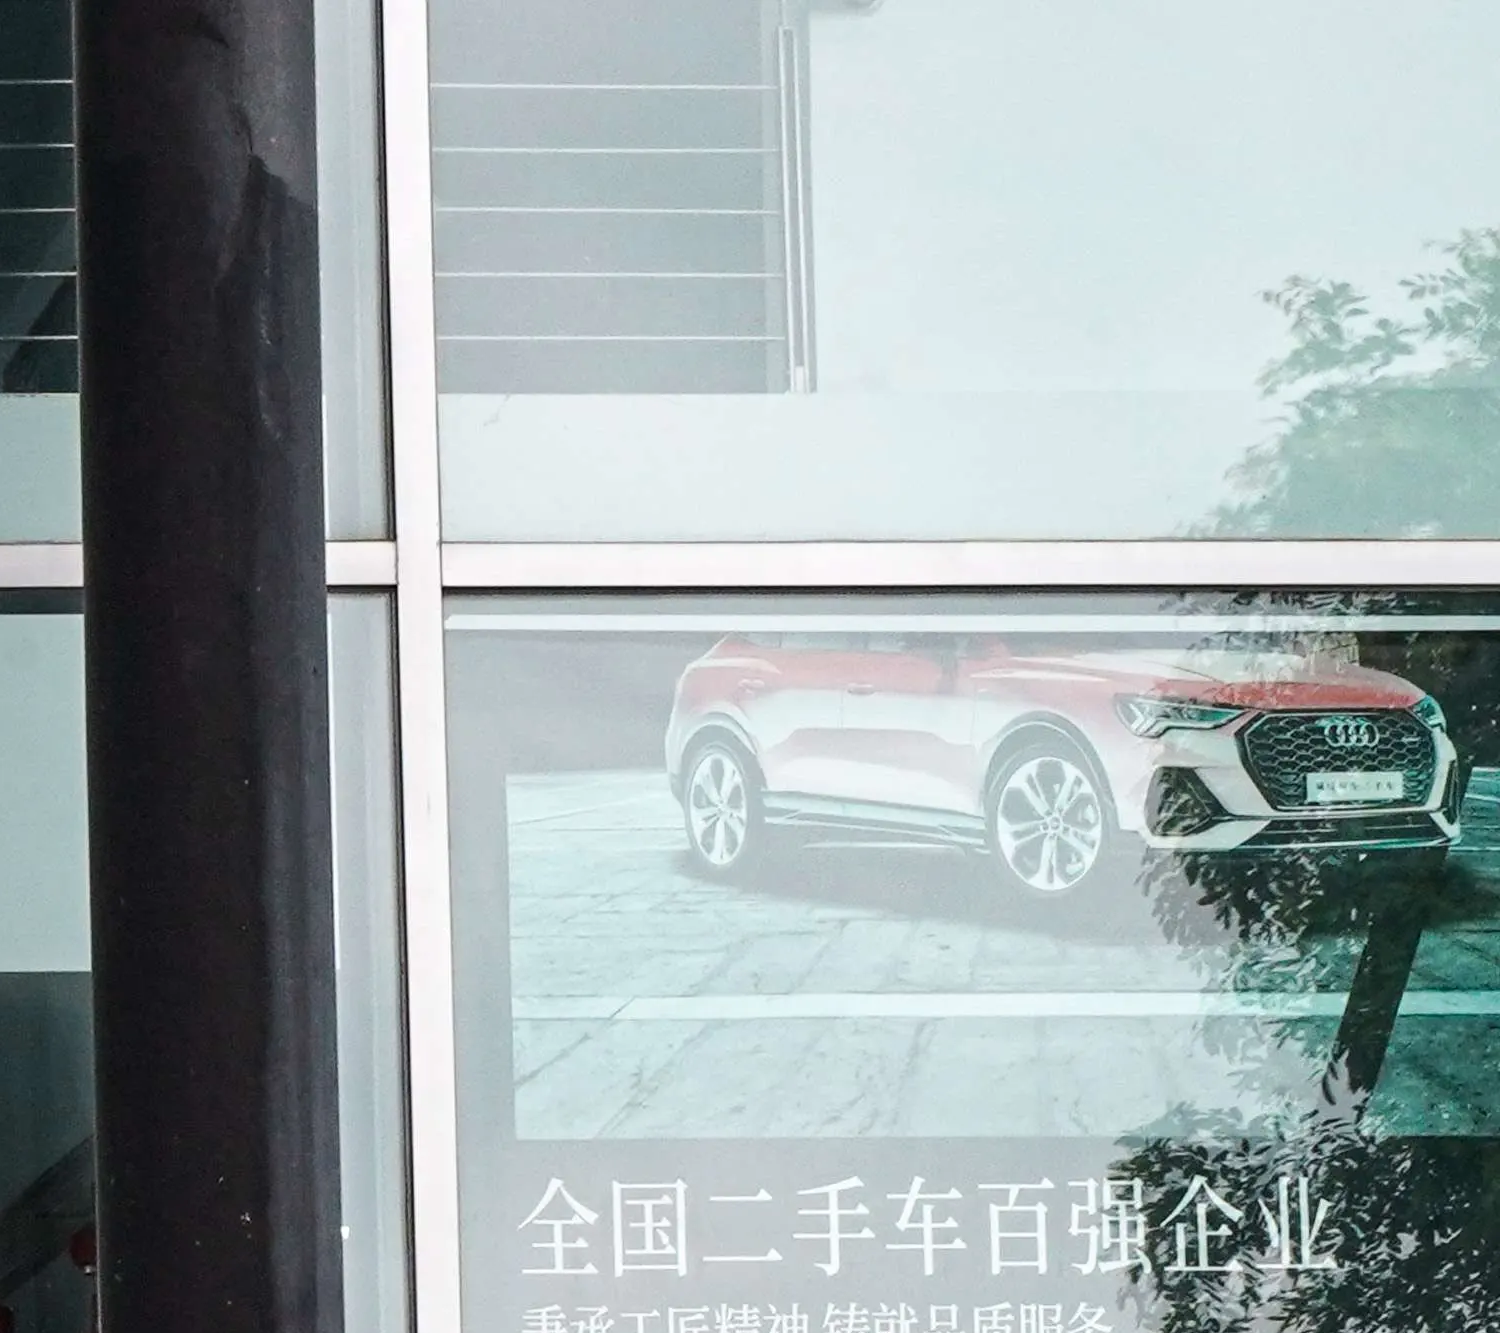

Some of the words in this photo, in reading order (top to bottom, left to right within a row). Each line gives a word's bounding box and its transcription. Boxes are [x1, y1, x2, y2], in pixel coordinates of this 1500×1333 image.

[516, 1175, 1339, 1278] 全国二手车百强企业
